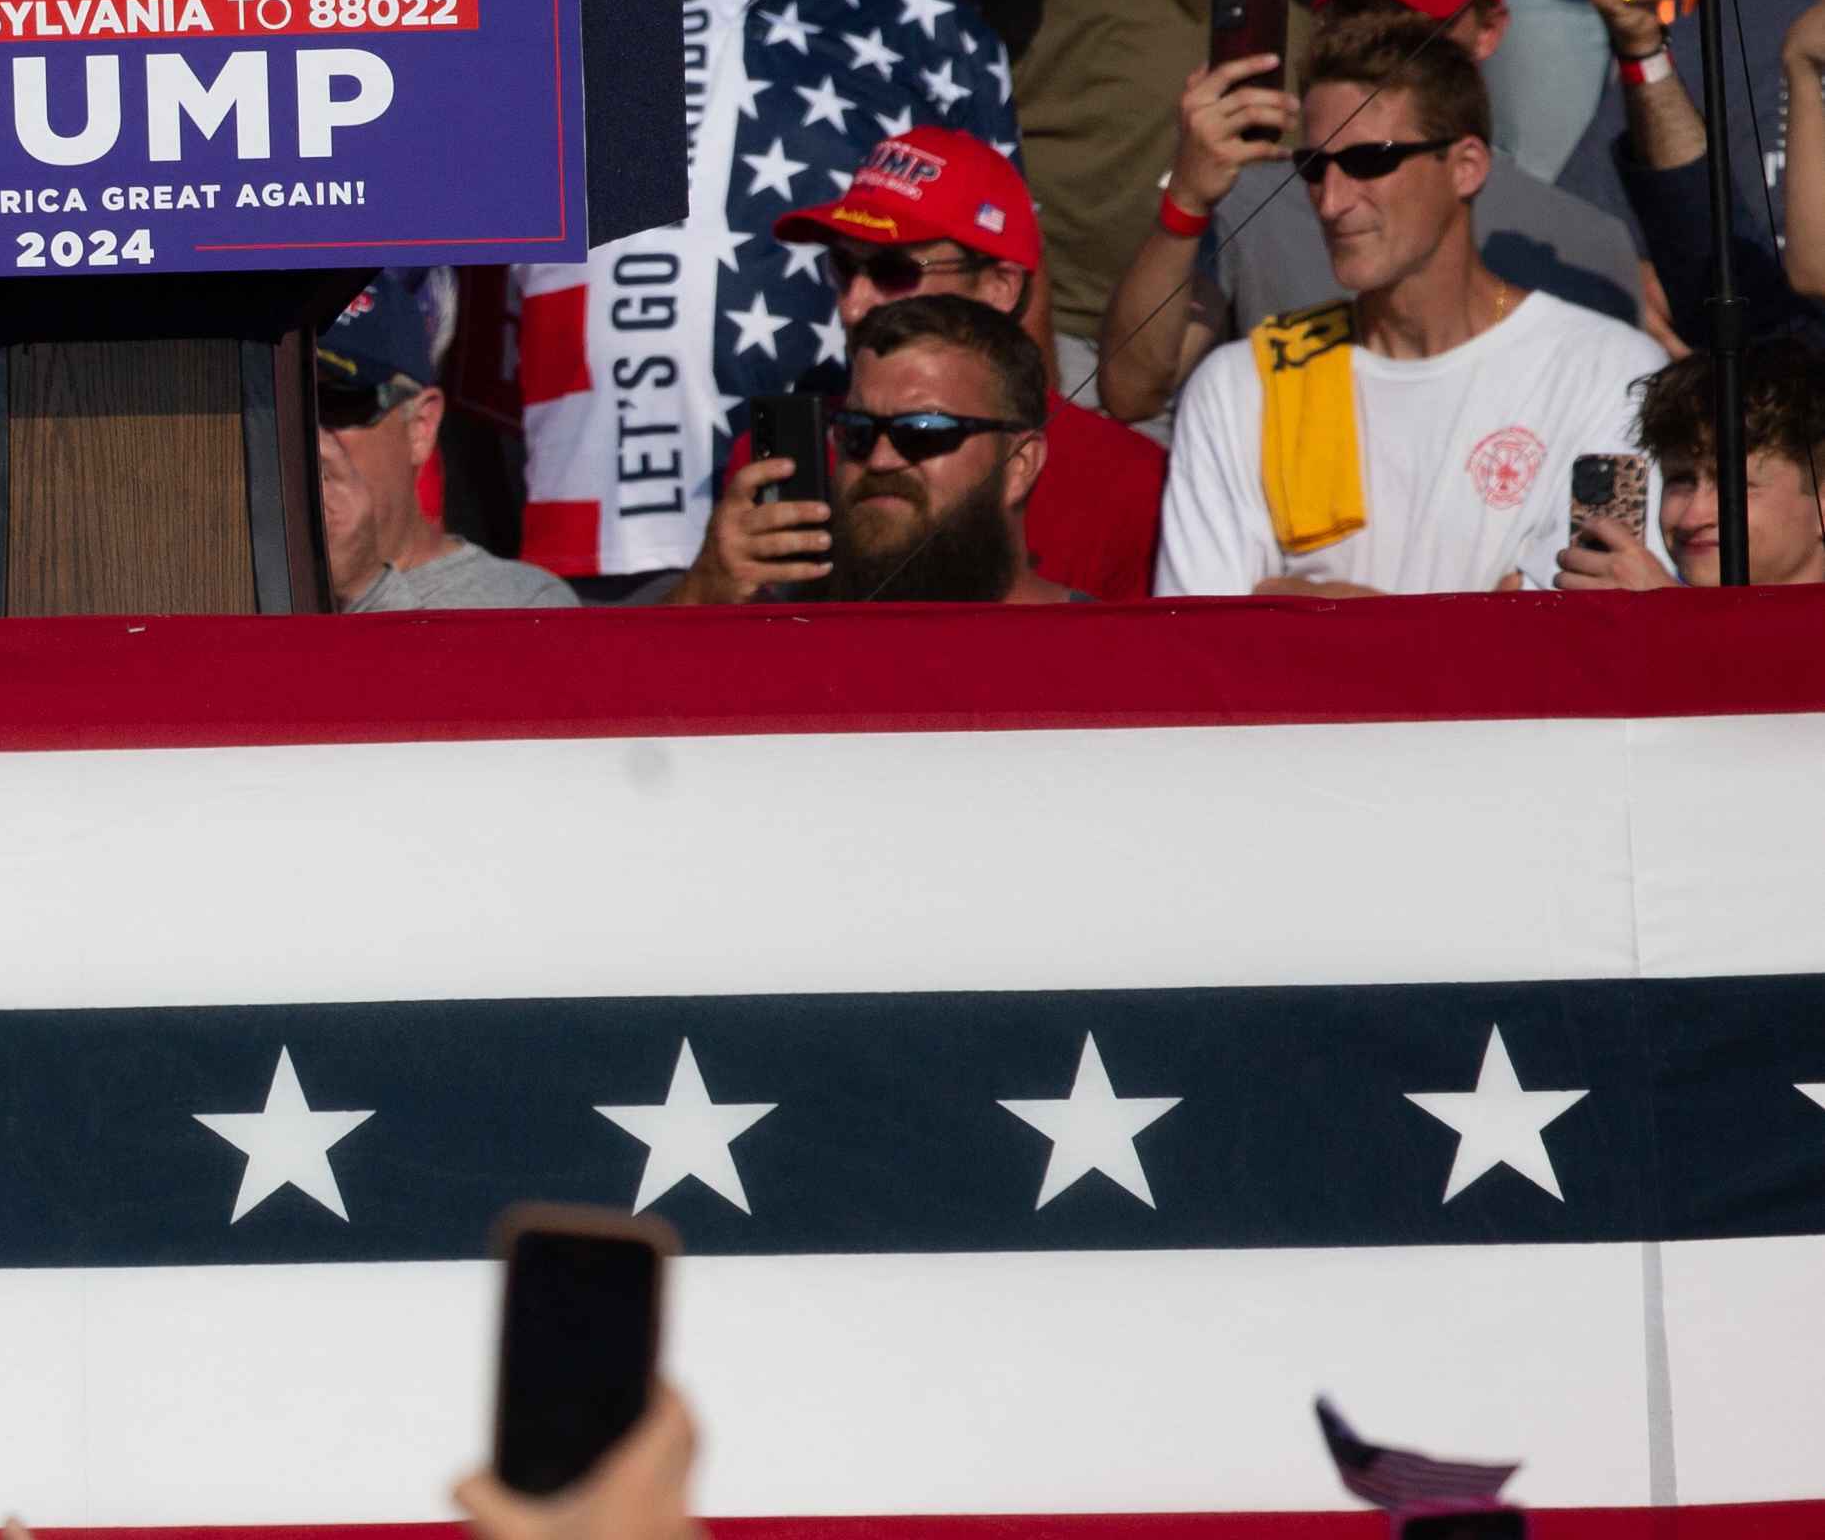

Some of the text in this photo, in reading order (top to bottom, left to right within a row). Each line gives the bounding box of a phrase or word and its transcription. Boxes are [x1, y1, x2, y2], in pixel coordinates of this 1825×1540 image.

[102, 184, 220, 212] GREAT
[236, 180, 365, 209] AGAIN!
[15, 229, 155, 268] 2024
[611, 250, 684, 518] LET'S GO
